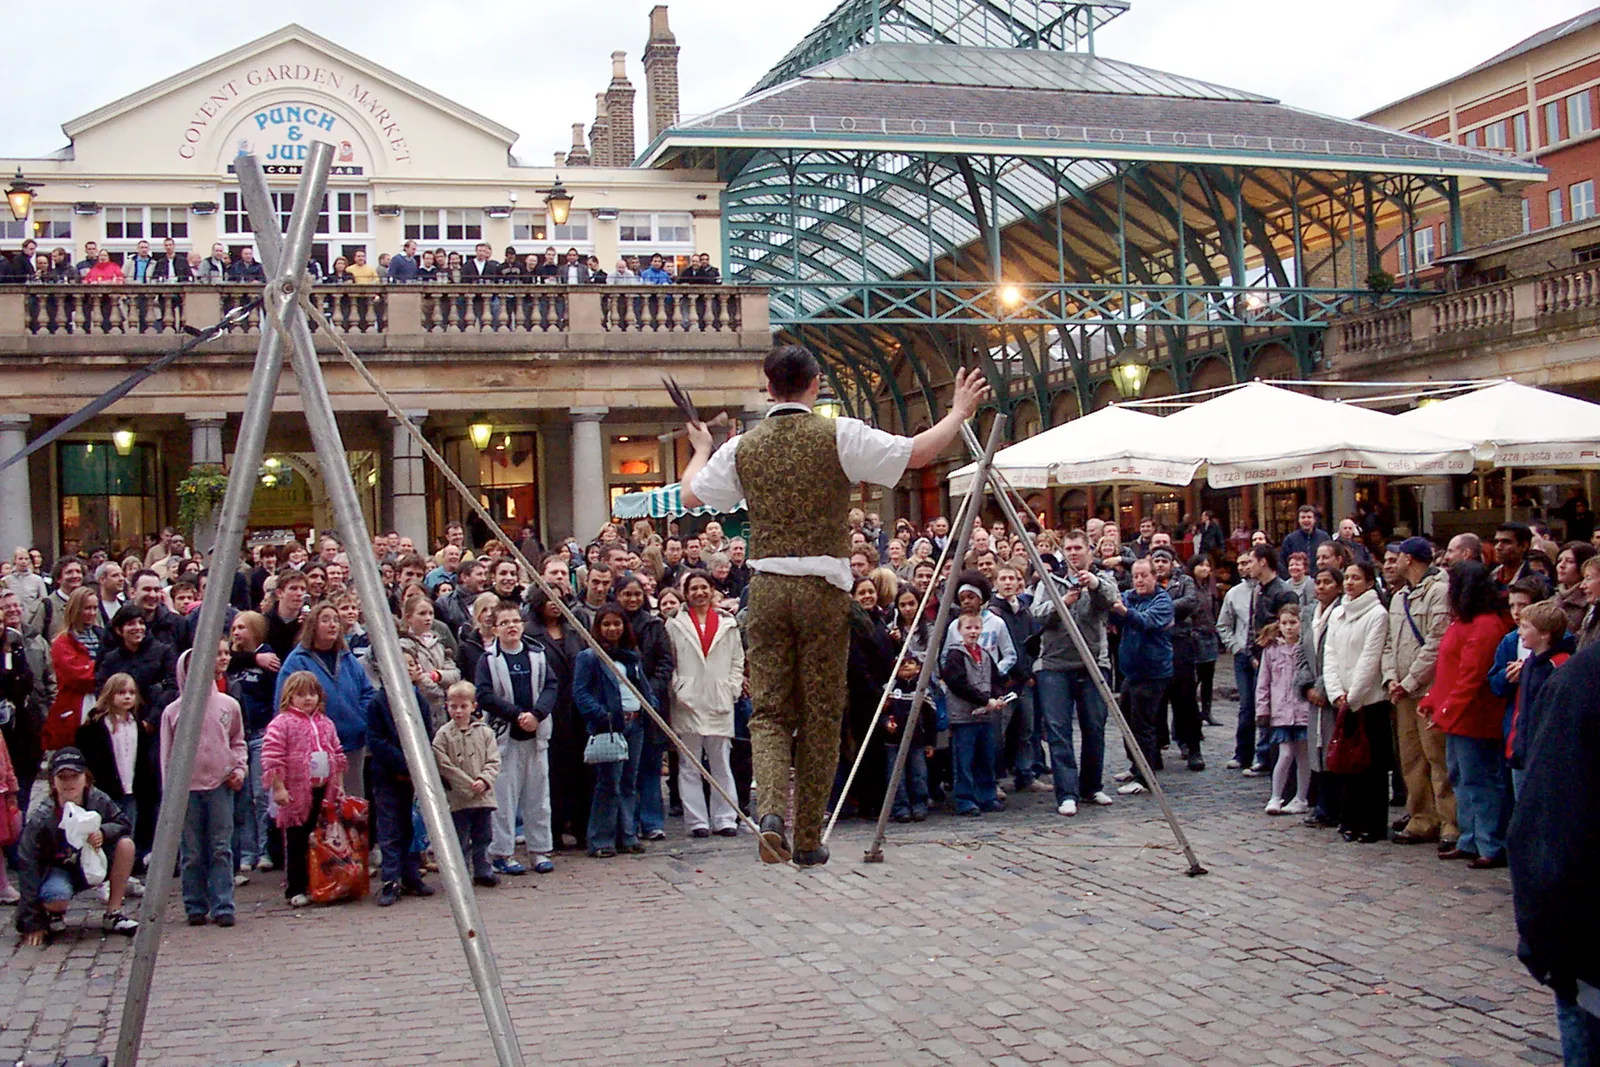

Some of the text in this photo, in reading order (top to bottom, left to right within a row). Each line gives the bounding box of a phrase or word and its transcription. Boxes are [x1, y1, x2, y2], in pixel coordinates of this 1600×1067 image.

[178, 64, 412, 165] COVENT GARDEN MARKET
[254, 106, 337, 132] PUNCH
[287, 125, 304, 142] &
[266, 144, 309, 161] JUD
[328, 166, 356, 175] AR
[1522, 451, 1551, 464] pasta
[1214, 471, 1241, 483] pizza
[1244, 468, 1278, 482] pasta
[1281, 465, 1303, 476] vino
[1312, 459, 1378, 472] FUEL
[1447, 459, 1464, 470] tea
